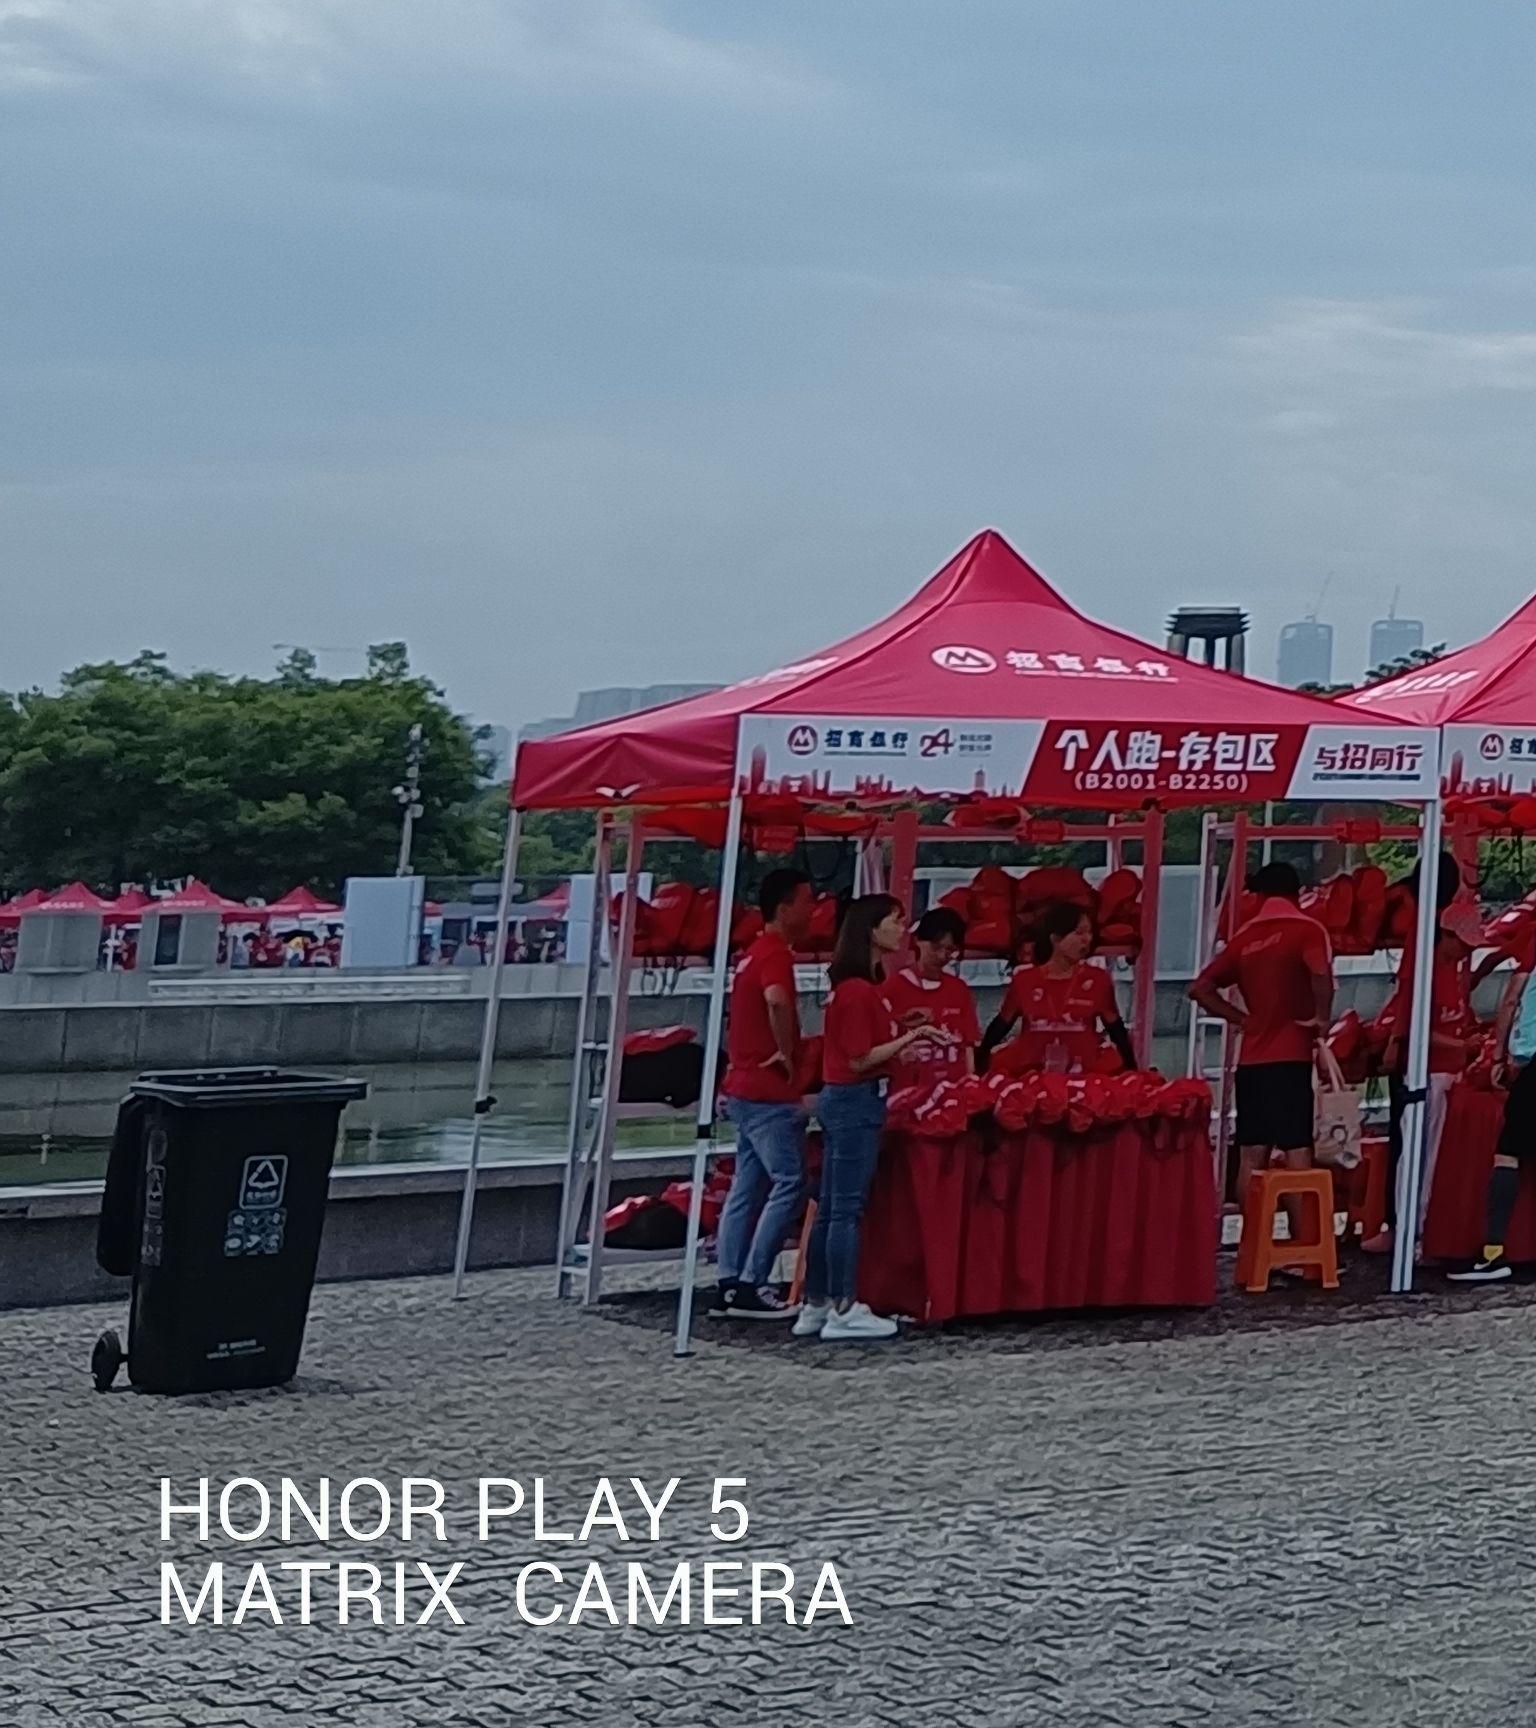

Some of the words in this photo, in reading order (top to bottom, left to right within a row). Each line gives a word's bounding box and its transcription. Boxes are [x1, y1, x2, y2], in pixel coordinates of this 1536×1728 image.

[1055, 728, 1280, 772] 个人跑-存包区
[1312, 742, 1424, 772] 与招同行
[1074, 771, 1249, 793] (B2001-B2250)
